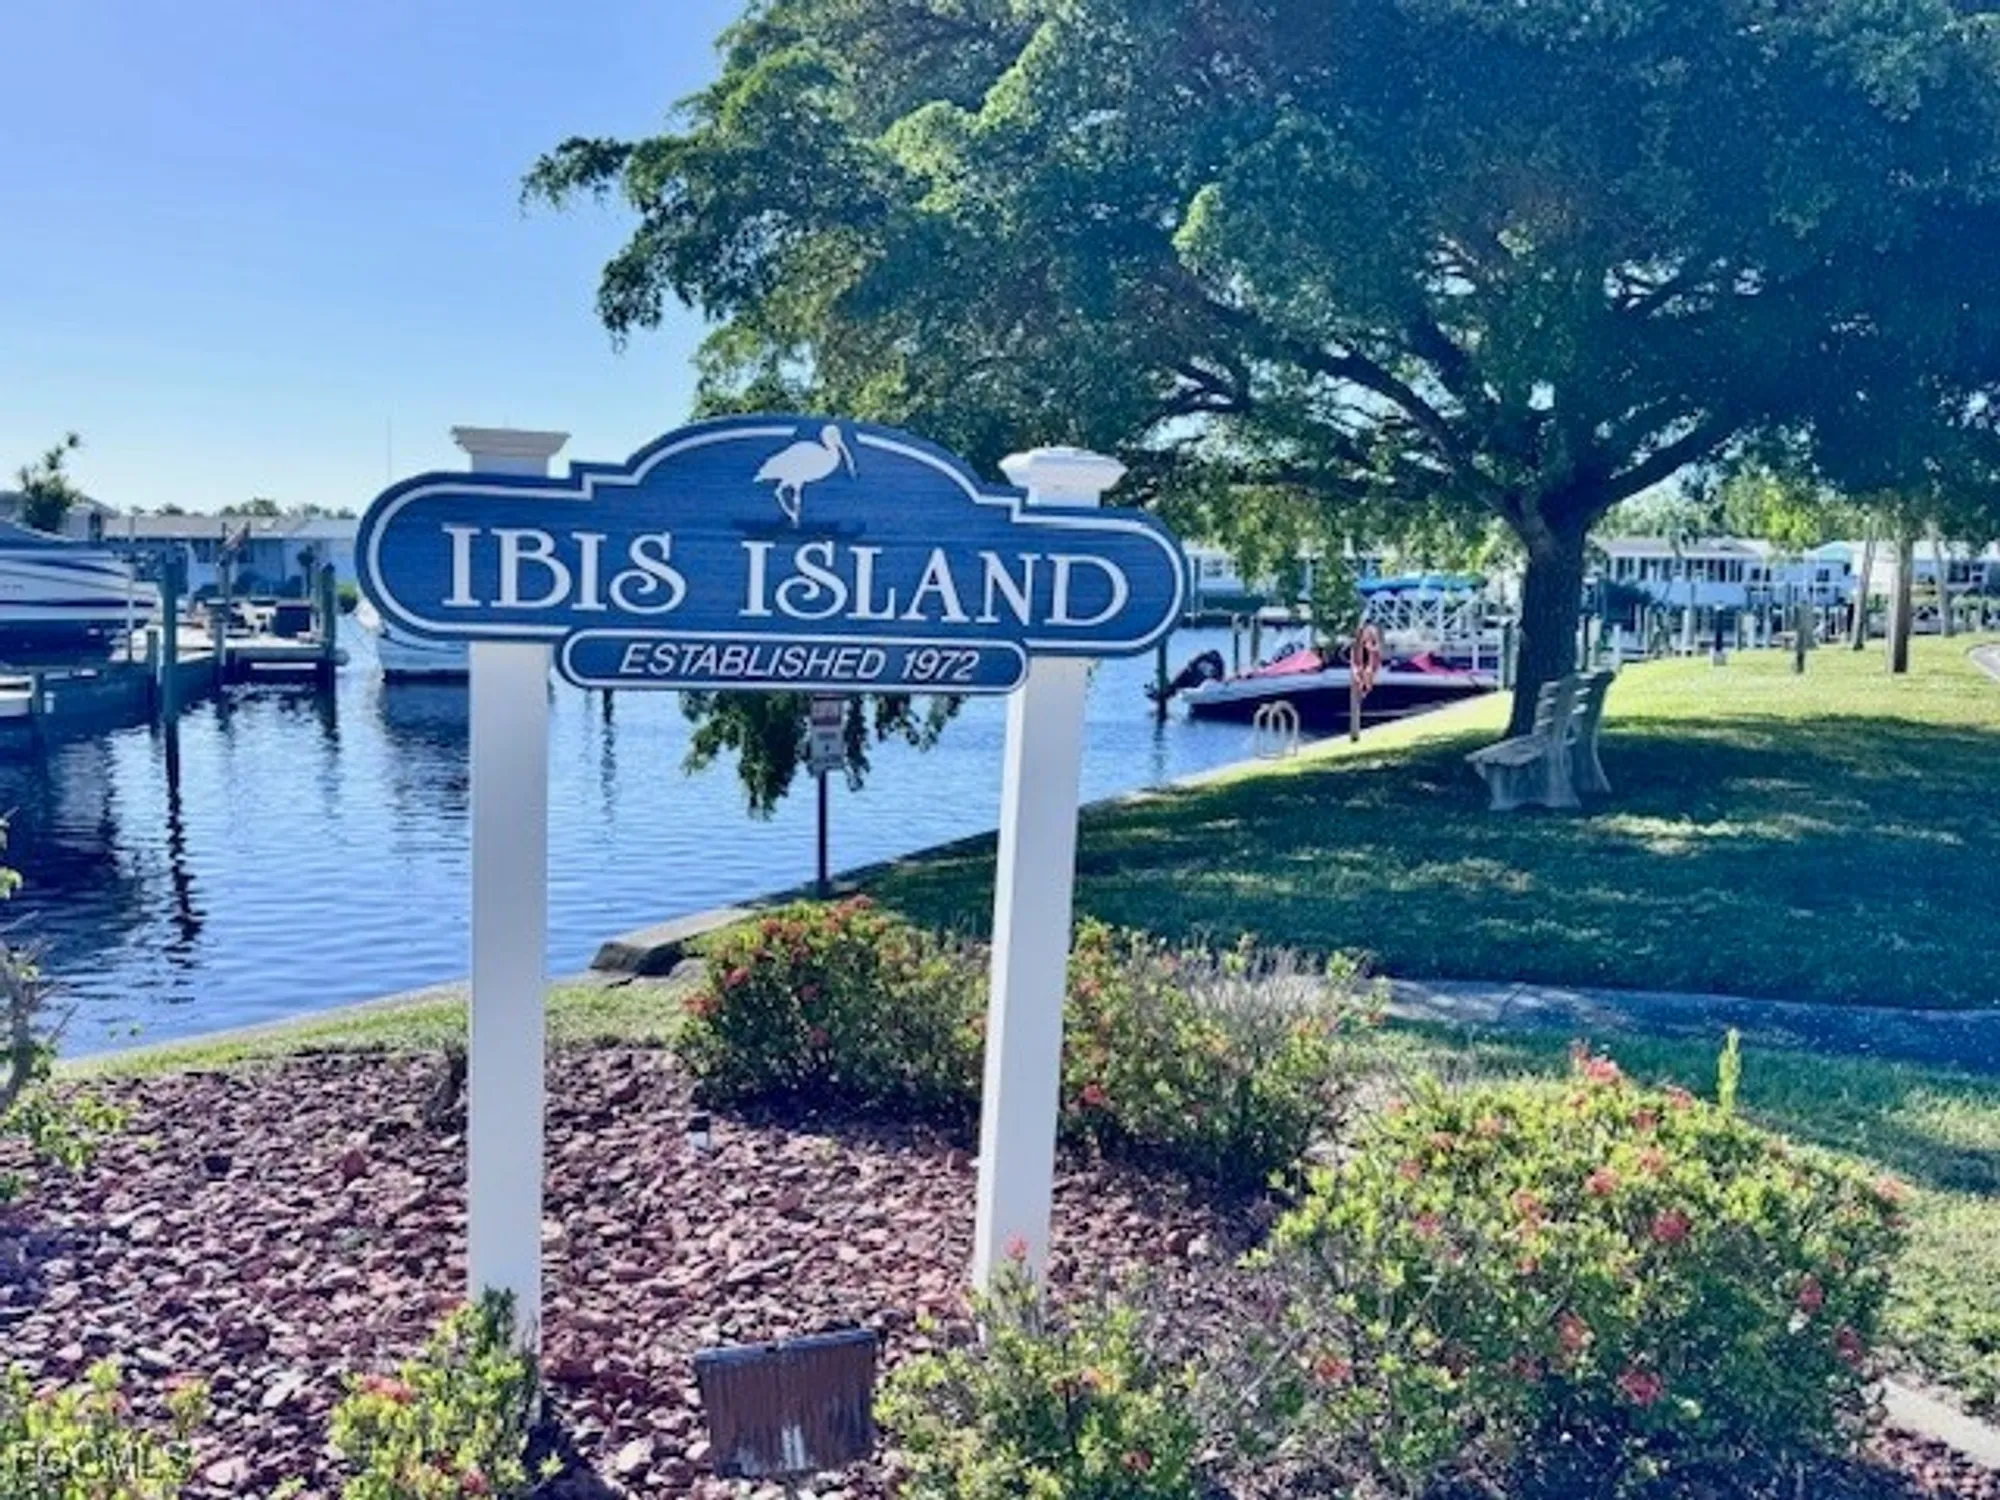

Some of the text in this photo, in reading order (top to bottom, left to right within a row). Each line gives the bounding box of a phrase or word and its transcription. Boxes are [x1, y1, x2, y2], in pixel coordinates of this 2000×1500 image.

[442, 525, 1130, 626] IBIS ISLAND
[619, 644, 980, 681] ESTABLISHED 1972
